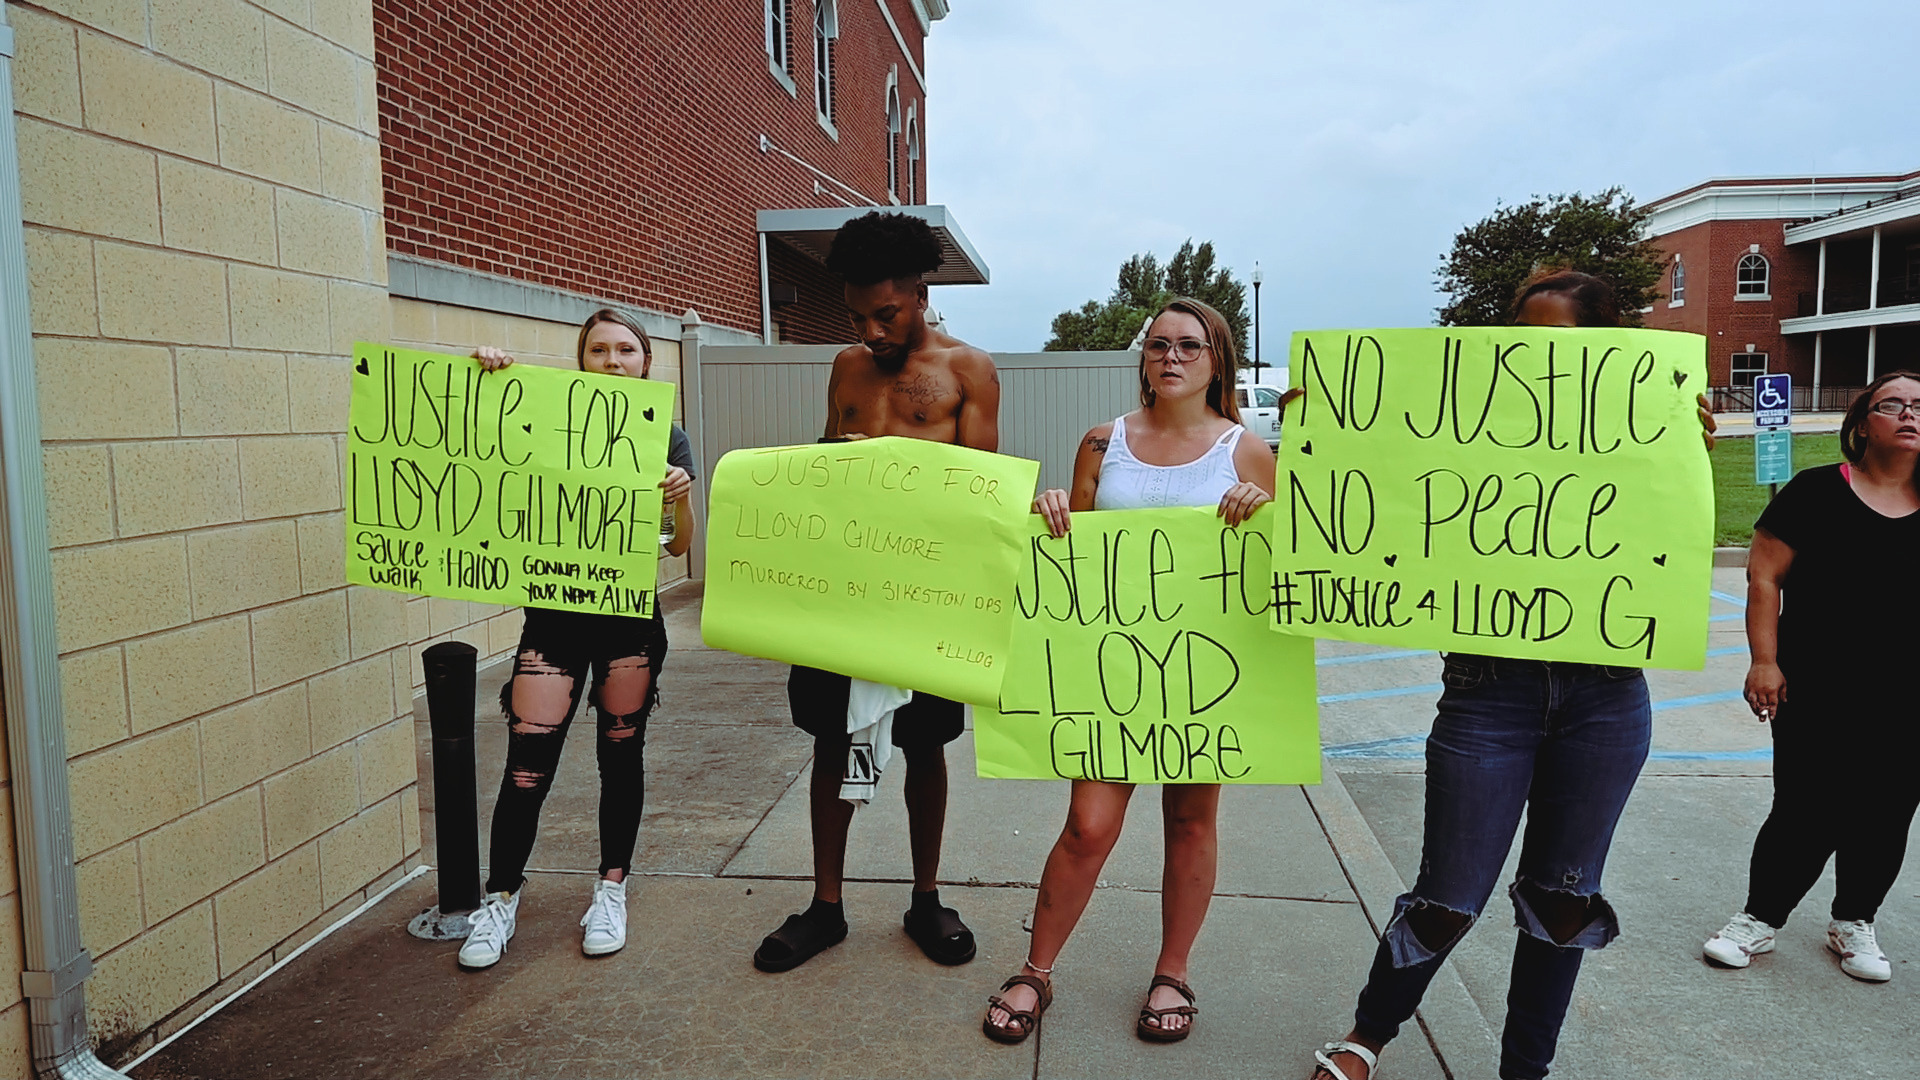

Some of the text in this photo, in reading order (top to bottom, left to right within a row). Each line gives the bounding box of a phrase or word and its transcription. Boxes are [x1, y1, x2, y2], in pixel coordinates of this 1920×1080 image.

[1300, 335, 1384, 432] NO
[352, 452, 653, 556] LLOYD GILMORE
[752, 446, 1003, 507] JUSTICE FOR
[735, 504, 945, 562] LLOYD GILMORE
[1289, 469, 1375, 555] NO
[522, 555, 581, 580] GONNA
[847, 581, 867, 599] BY
[882, 580, 967, 608] SIKESTON
[974, 596, 1002, 614] DPS
[521, 581, 653, 616] YOUR NAME ALIVE
[1416, 589, 1442, 621] 4
[1452, 579, 1573, 642] LLOYD
[1599, 575, 1657, 661] G
